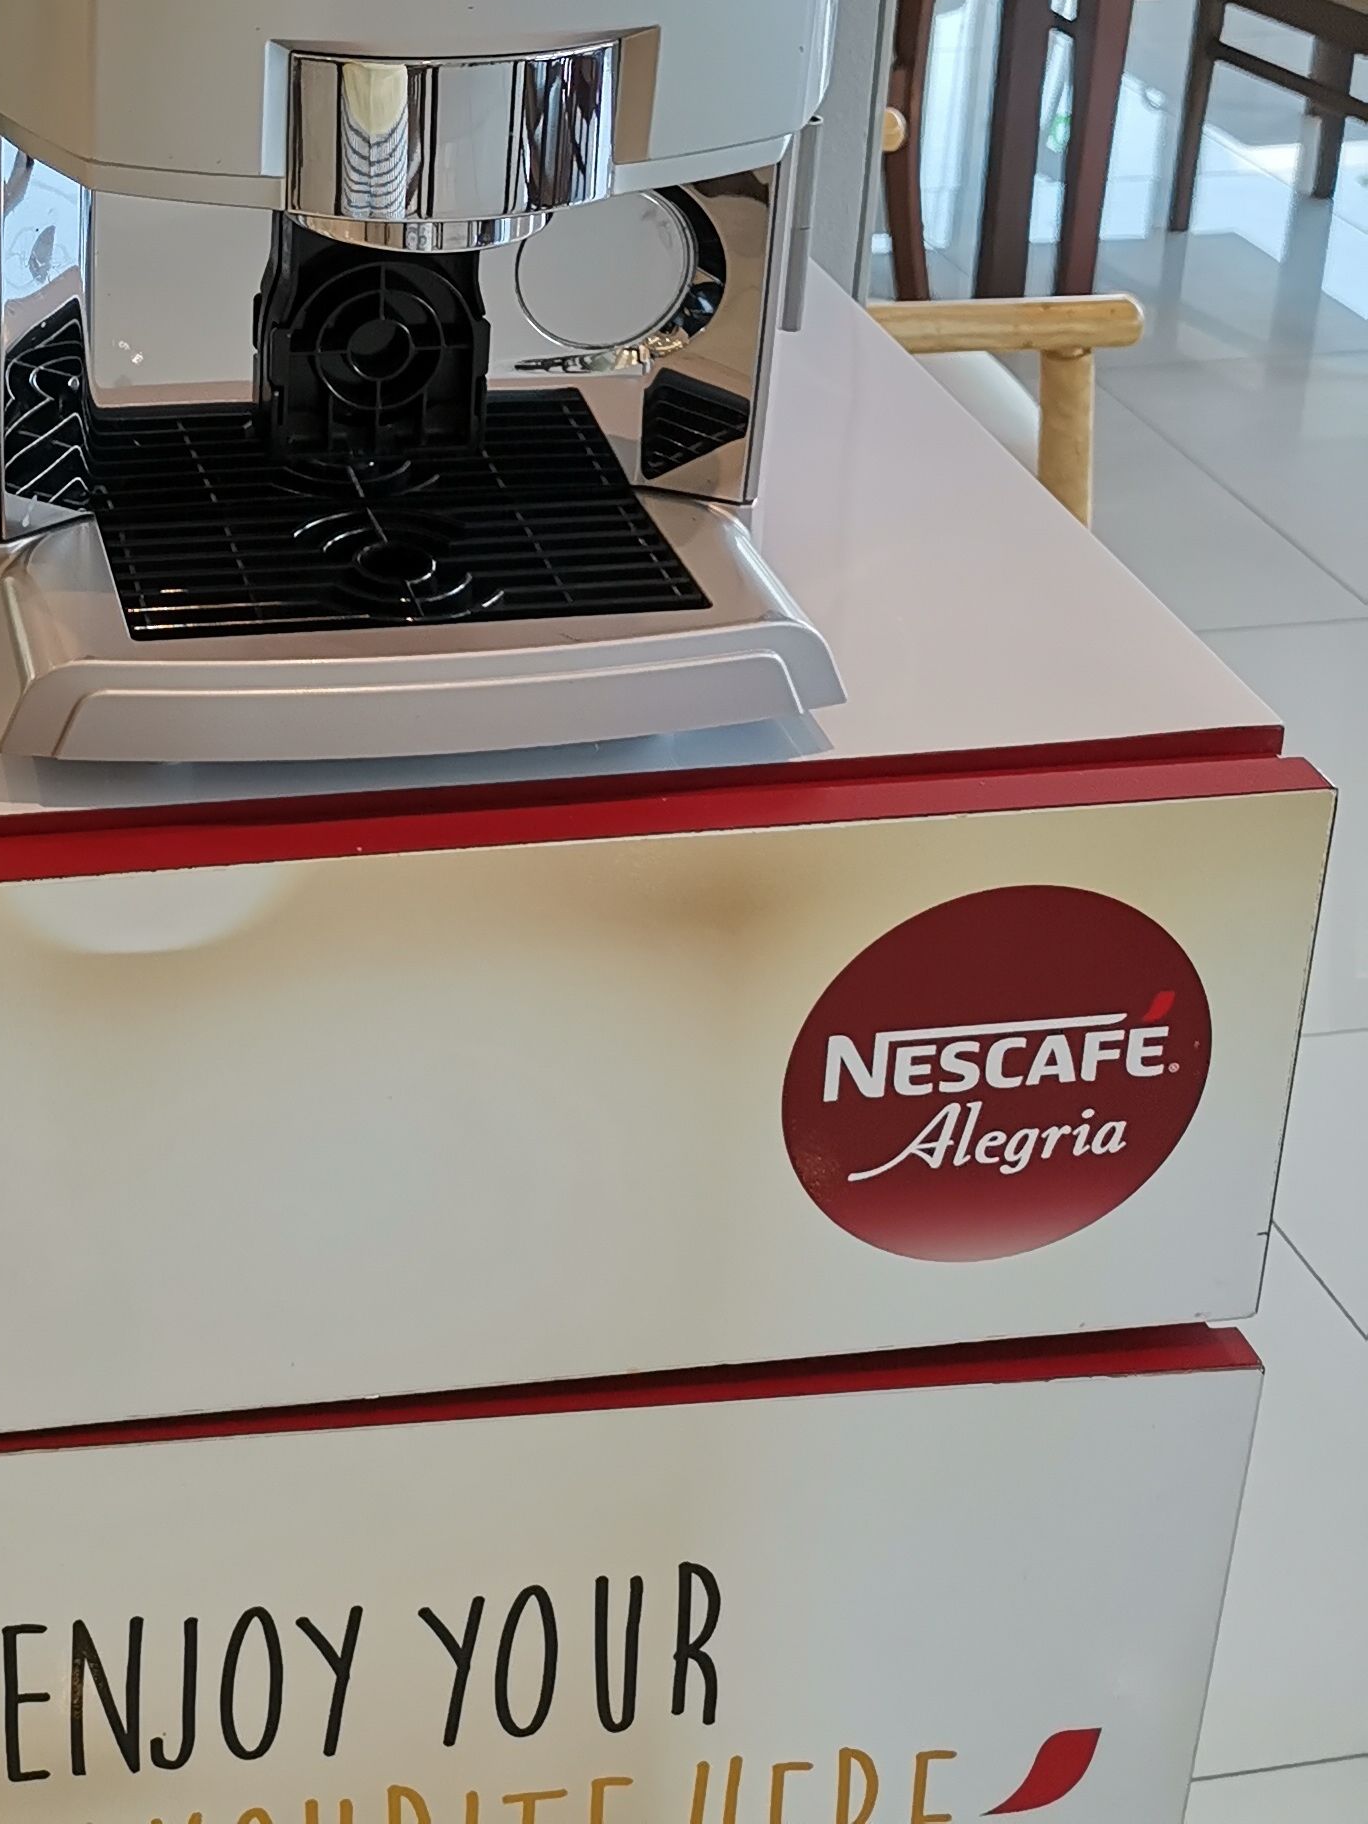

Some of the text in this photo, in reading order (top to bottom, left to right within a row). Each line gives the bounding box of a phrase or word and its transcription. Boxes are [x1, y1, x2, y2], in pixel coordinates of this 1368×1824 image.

[847, 1102, 1127, 1182] Alegria
[1, 1561, 722, 1783] ENJOY YOUR
